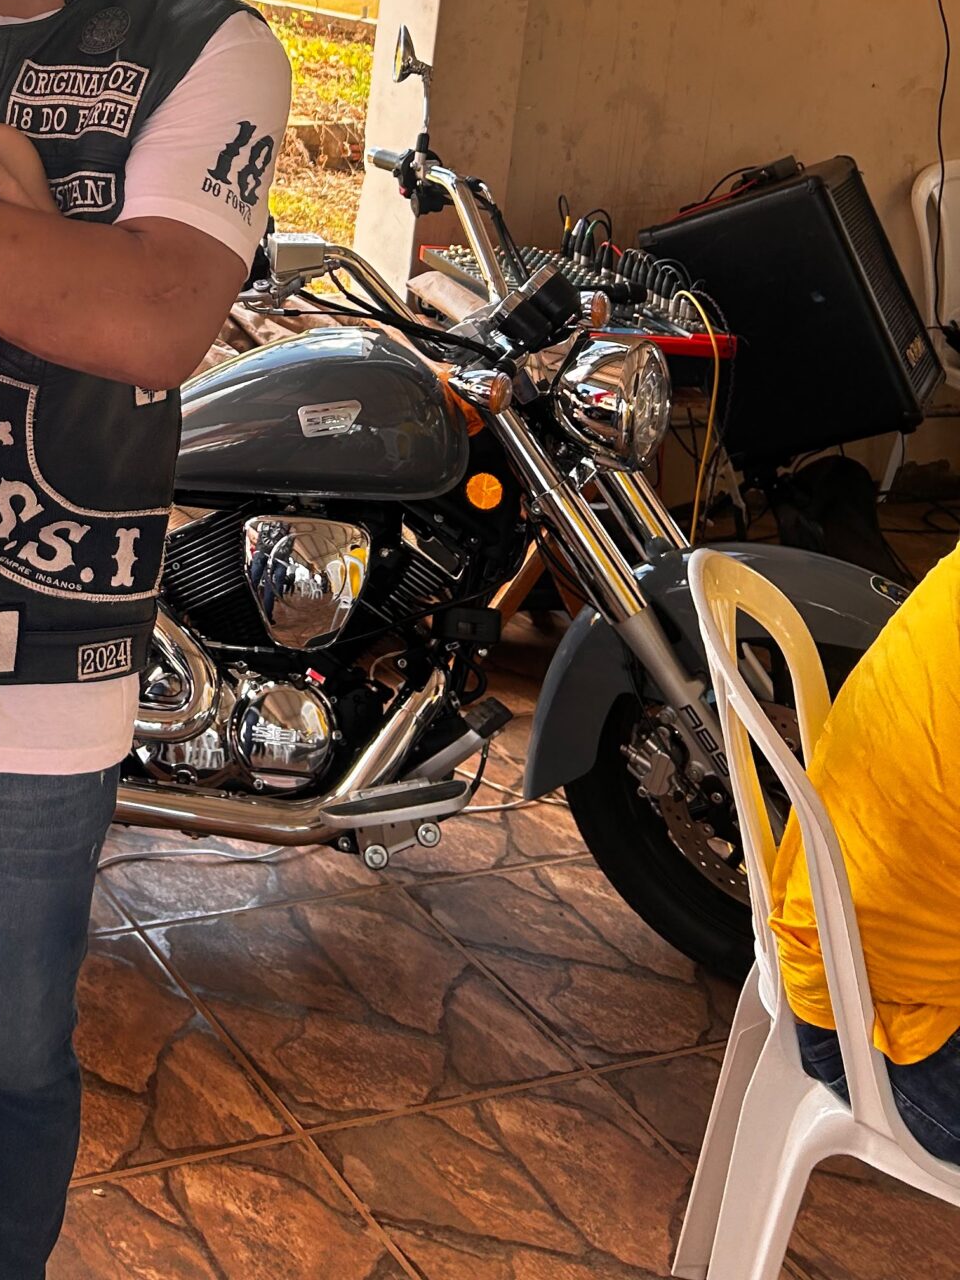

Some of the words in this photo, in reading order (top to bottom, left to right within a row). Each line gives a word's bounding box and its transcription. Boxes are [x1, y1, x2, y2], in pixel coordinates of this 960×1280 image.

[10, 104, 33, 130] 18
[39, 106, 68, 132] DO
[75, 101, 130, 133] FRTE
[206, 120, 275, 207] 18
[201, 176, 222, 198] DO
[35, 572, 83, 592] INSANOS
[83, 642, 128, 674] 2024
